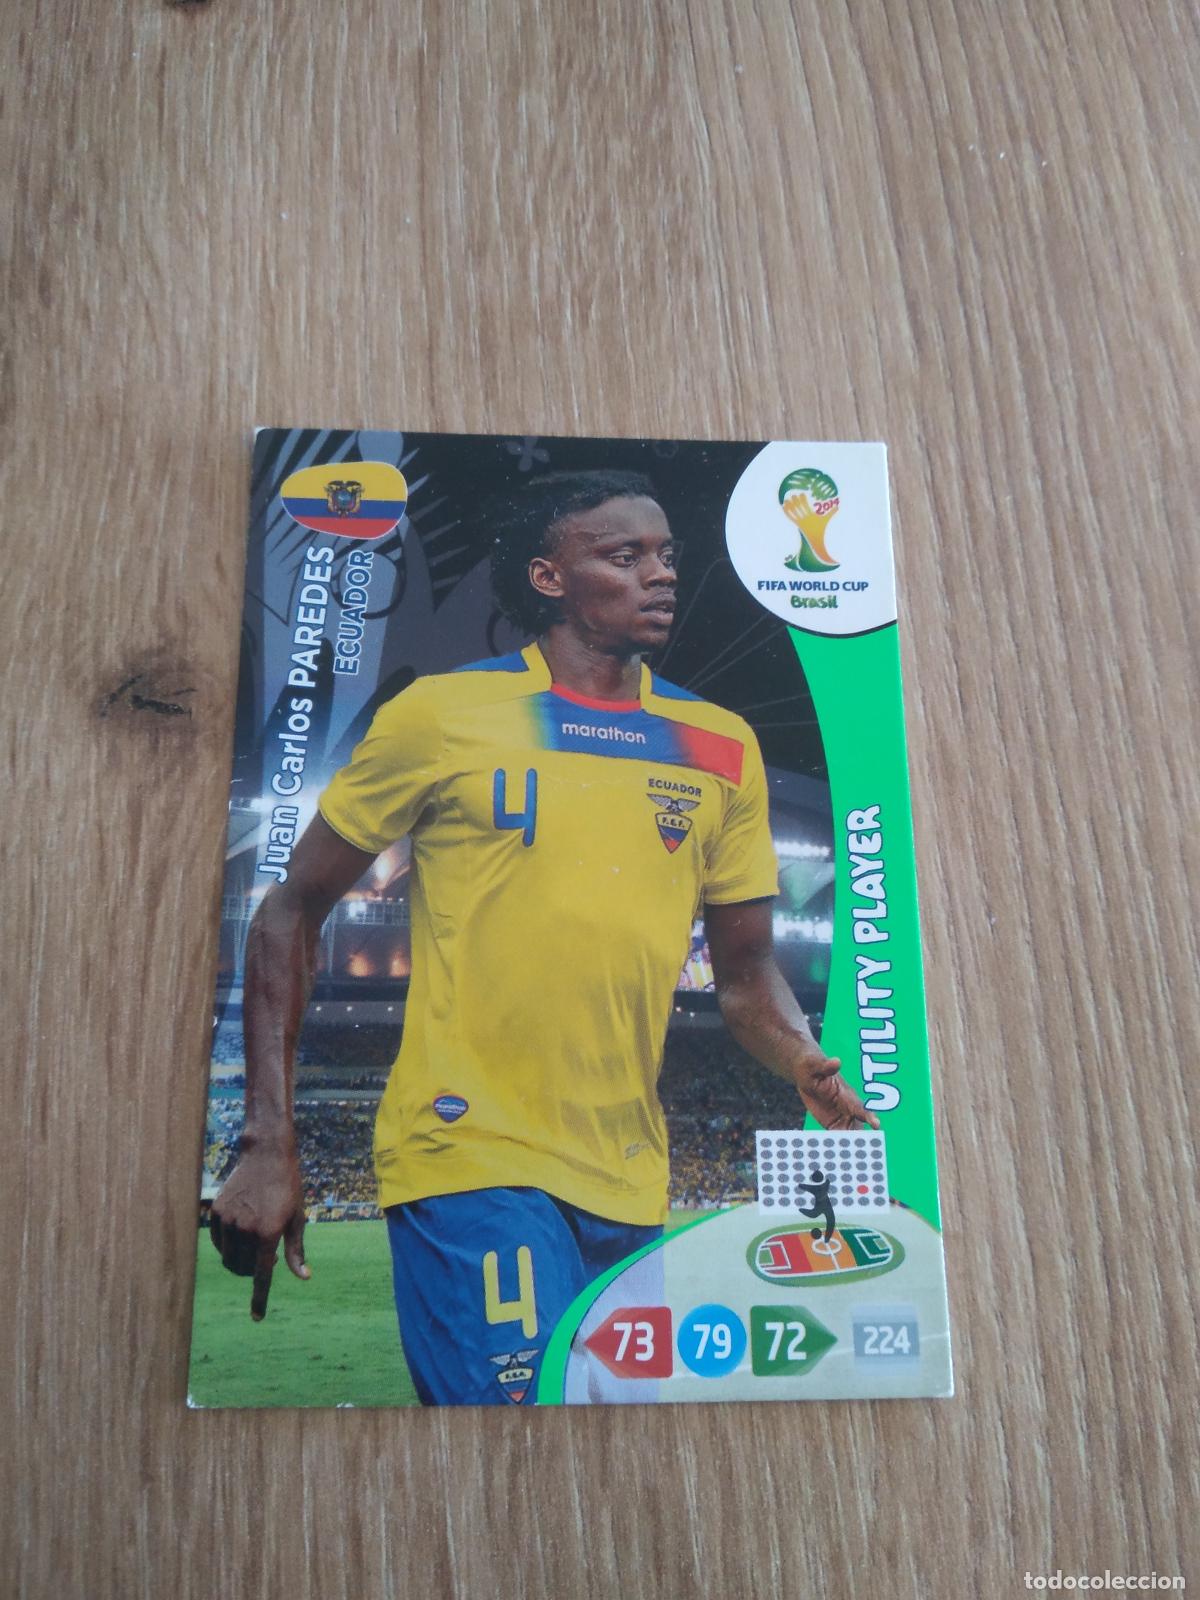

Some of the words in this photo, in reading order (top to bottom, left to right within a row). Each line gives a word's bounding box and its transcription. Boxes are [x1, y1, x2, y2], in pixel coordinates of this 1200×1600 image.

[288, 545, 335, 686] PAREDES
[333, 549, 374, 676] ECUADOR
[757, 580, 787, 591] FIFA
[788, 581, 840, 592] WORLD
[842, 581, 869, 592] CUP
[790, 595, 838, 608] Brasil
[271, 698, 313, 796] Carlos
[562, 722, 647, 744] marathon
[493, 767, 538, 847] 4
[648, 778, 702, 797] ECUADOR
[258, 805, 299, 883] Juan
[845, 803, 890, 944] PLAYER
[855, 953, 901, 1112] UTILITY
[482, 1245, 539, 1340] 4
[613, 1321, 655, 1362] 73
[693, 1323, 732, 1360] 79
[765, 1321, 807, 1361] 72
[863, 1326, 911, 1355] 224
